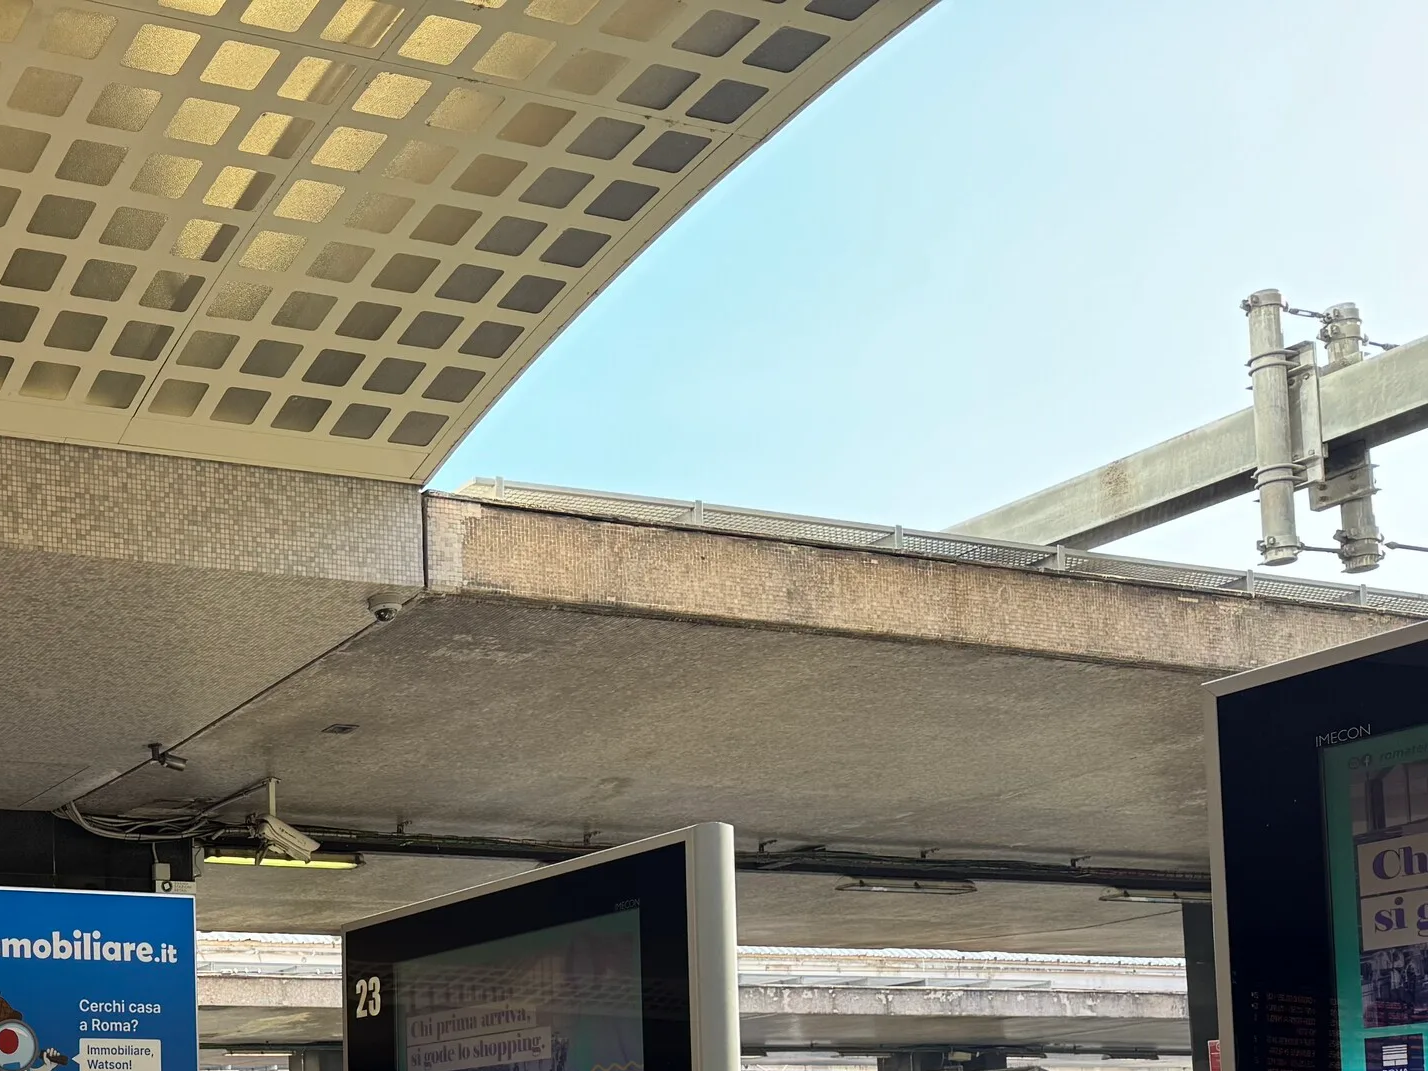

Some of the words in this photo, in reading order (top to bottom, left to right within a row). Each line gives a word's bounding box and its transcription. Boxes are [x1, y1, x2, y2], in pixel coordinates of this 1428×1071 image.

[1315, 723, 1371, 748] IMECON
[1374, 896, 1409, 934] si
[79, 999, 125, 1013] Cerchi
[128, 1002, 161, 1014] casa
[355, 976, 381, 1019] 23
[79, 1020, 88, 1032] a
[91, 1018, 139, 1032] Roma?
[410, 1016, 433, 1039] Chi
[436, 1012, 478, 1041] prima
[480, 1003, 531, 1028] arriva,
[87, 1044, 154, 1058] Immobiliare,
[410, 1047, 422, 1067] si
[423, 1044, 456, 1071] gode
[458, 1043, 471, 1060] lo
[473, 1032, 546, 1062] shopping.
[87, 1059, 133, 1070] Watson!
